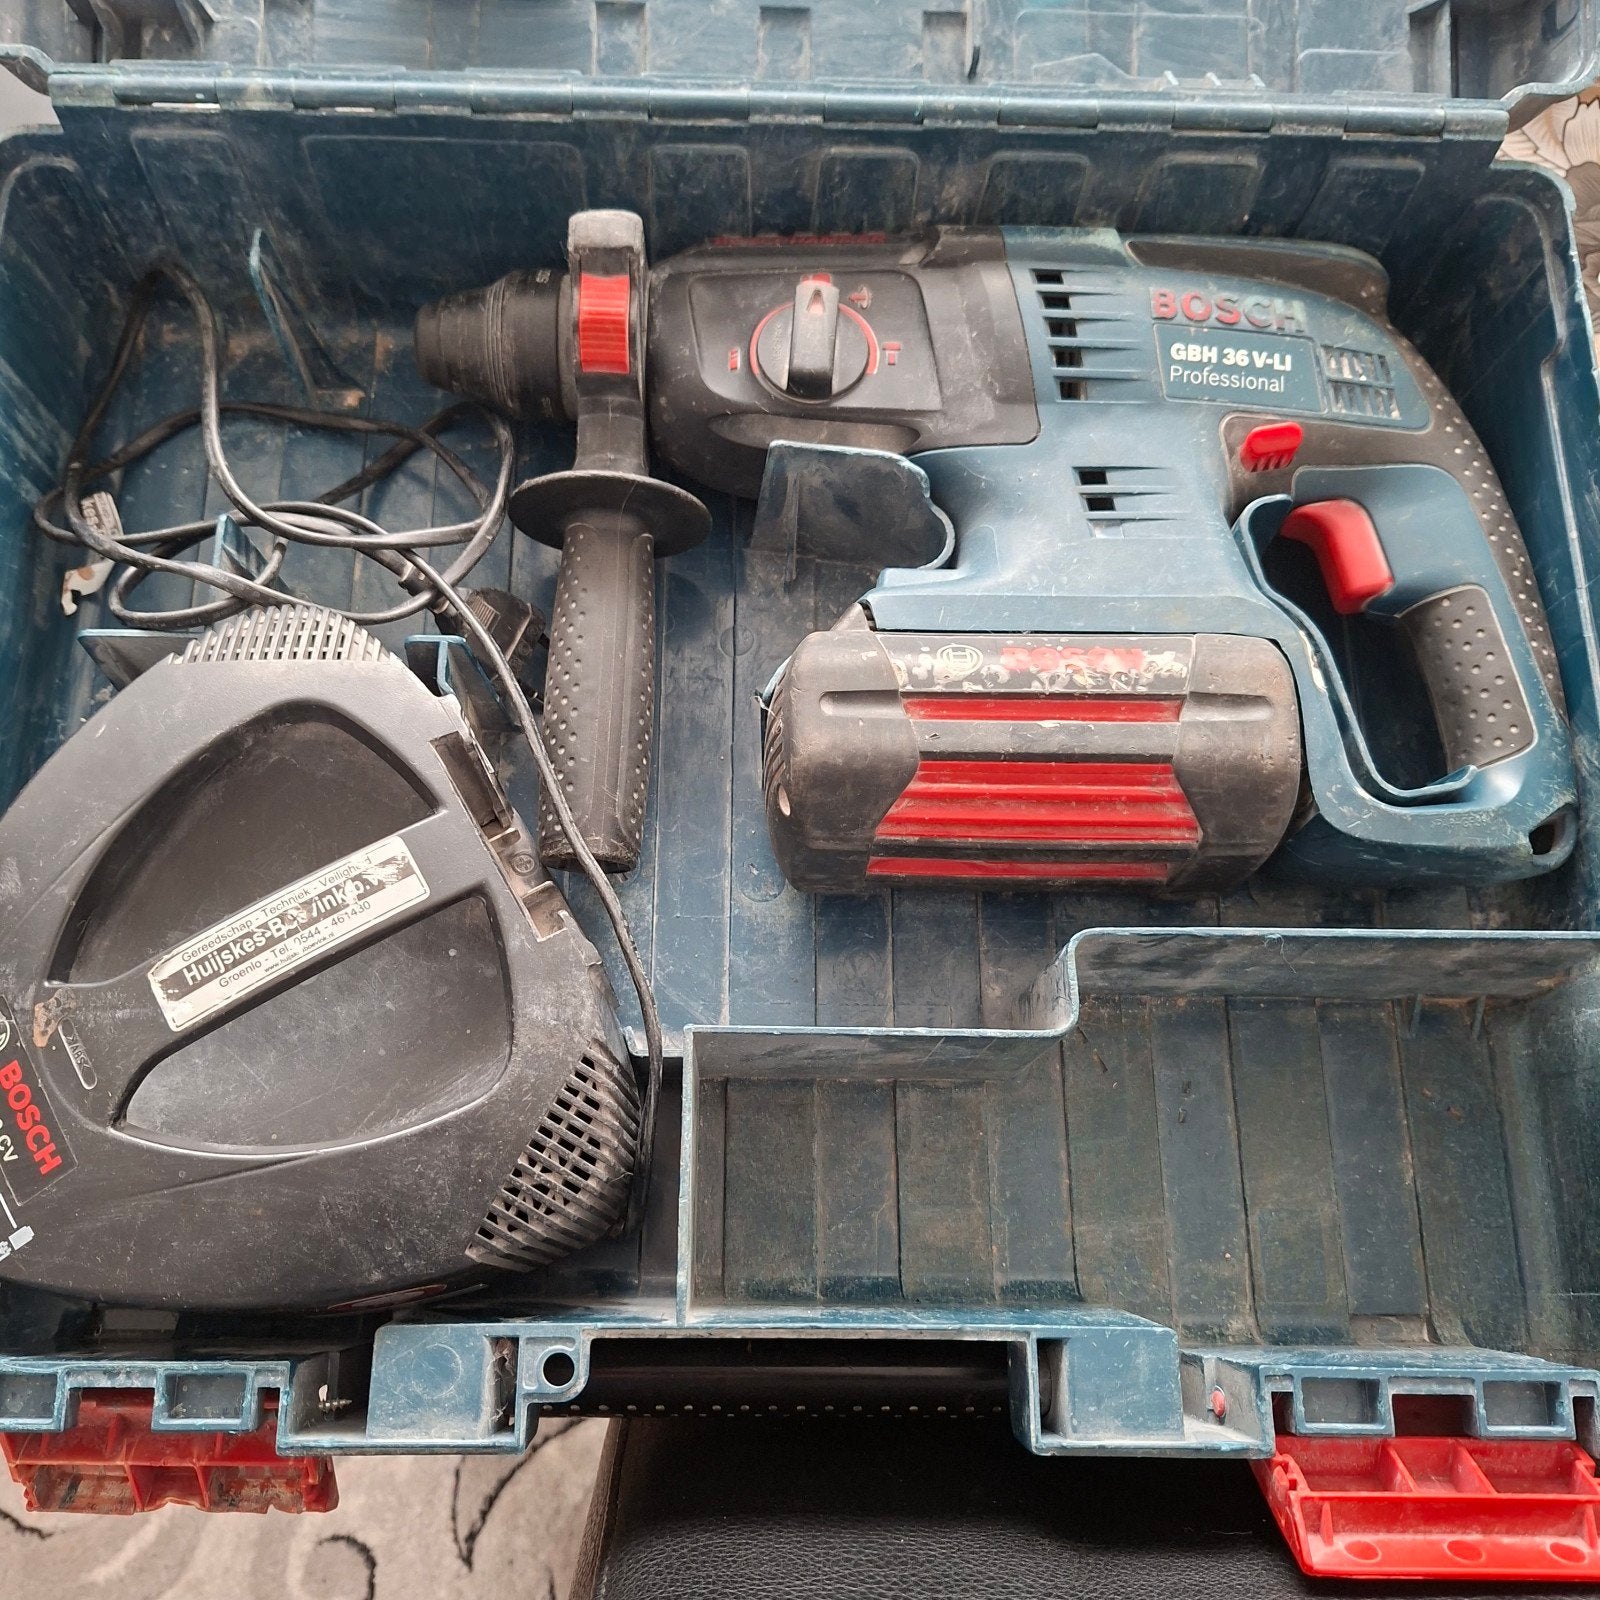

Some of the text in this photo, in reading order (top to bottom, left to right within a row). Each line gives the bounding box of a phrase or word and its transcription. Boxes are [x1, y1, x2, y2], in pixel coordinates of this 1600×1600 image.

[1151, 288, 1306, 333] BOSCH
[1170, 342, 1292, 372] GBH 36 V-LI
[1170, 365, 1285, 393] Professional
[181, 919, 253, 962] Gereedschap
[261, 888, 312, 918] Techniek
[219, 958, 262, 988] Groenlo
[270, 943, 293, 959] Tel.
[0, 1060, 62, 1175] BOSCH
